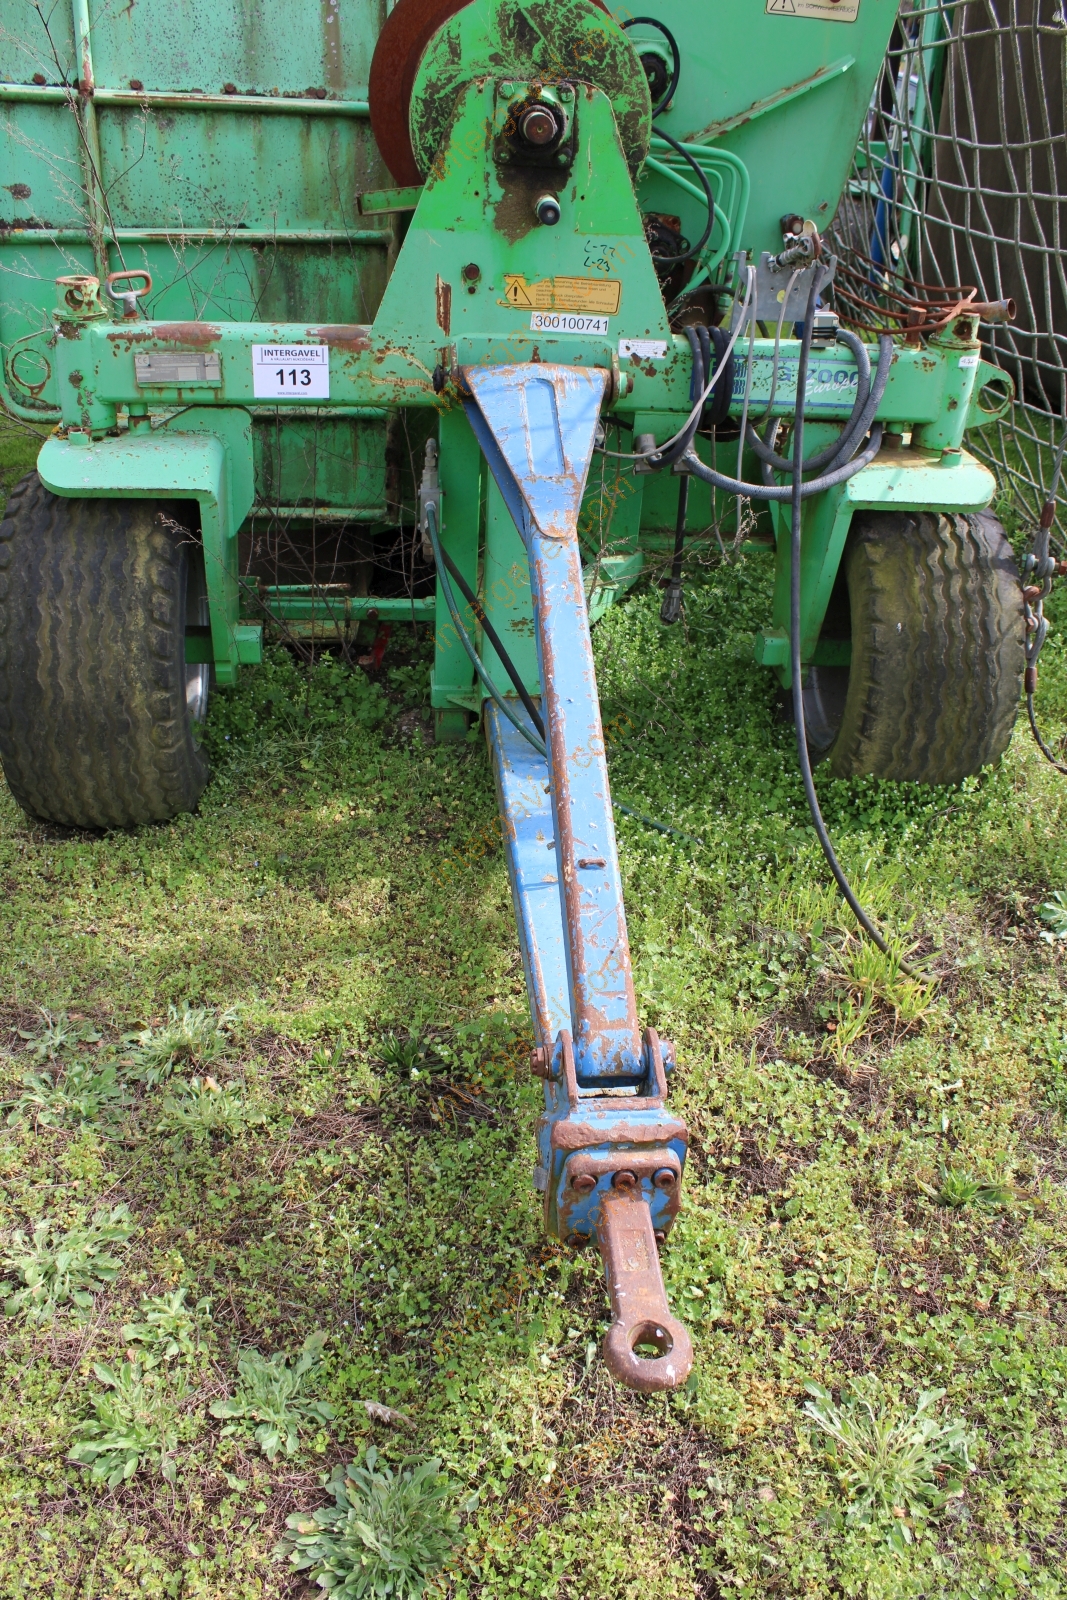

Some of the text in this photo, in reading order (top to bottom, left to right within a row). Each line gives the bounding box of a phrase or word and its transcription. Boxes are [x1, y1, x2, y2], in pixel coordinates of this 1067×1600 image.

[535, 315, 608, 332] 300100741
[264, 349, 321, 357] INTERGAVEL
[276, 368, 312, 386] 113
[804, 377, 861, 397] Europe
